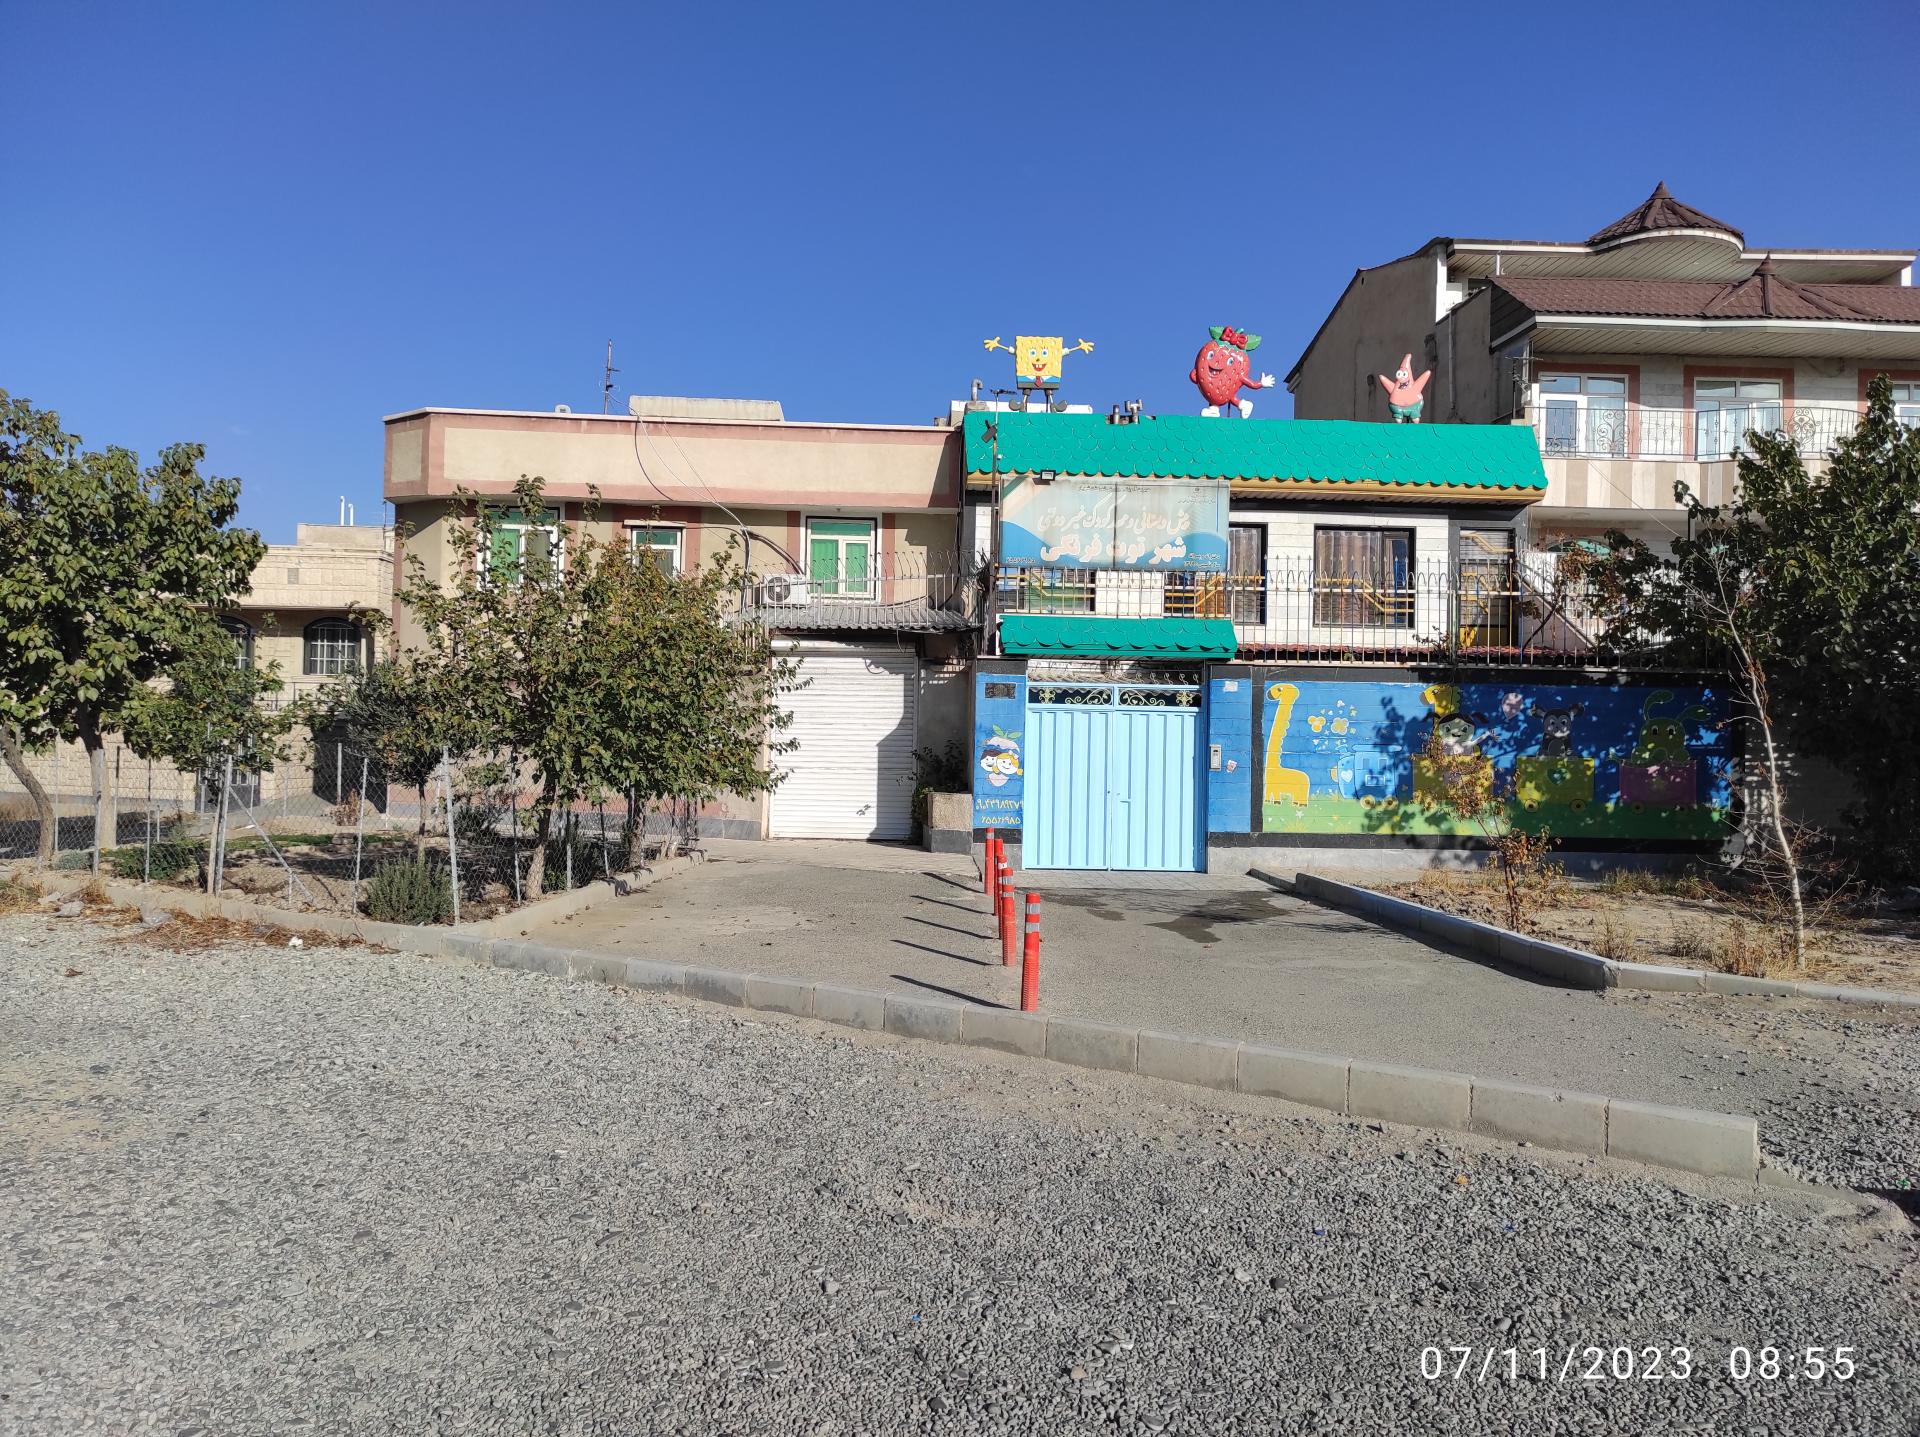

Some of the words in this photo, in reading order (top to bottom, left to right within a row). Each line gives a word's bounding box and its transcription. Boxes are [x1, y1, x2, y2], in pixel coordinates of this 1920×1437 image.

[1040, 532, 1103, 563] فرنگی
[1106, 536, 1146, 564] توت
[1148, 536, 1187, 565] شهر
